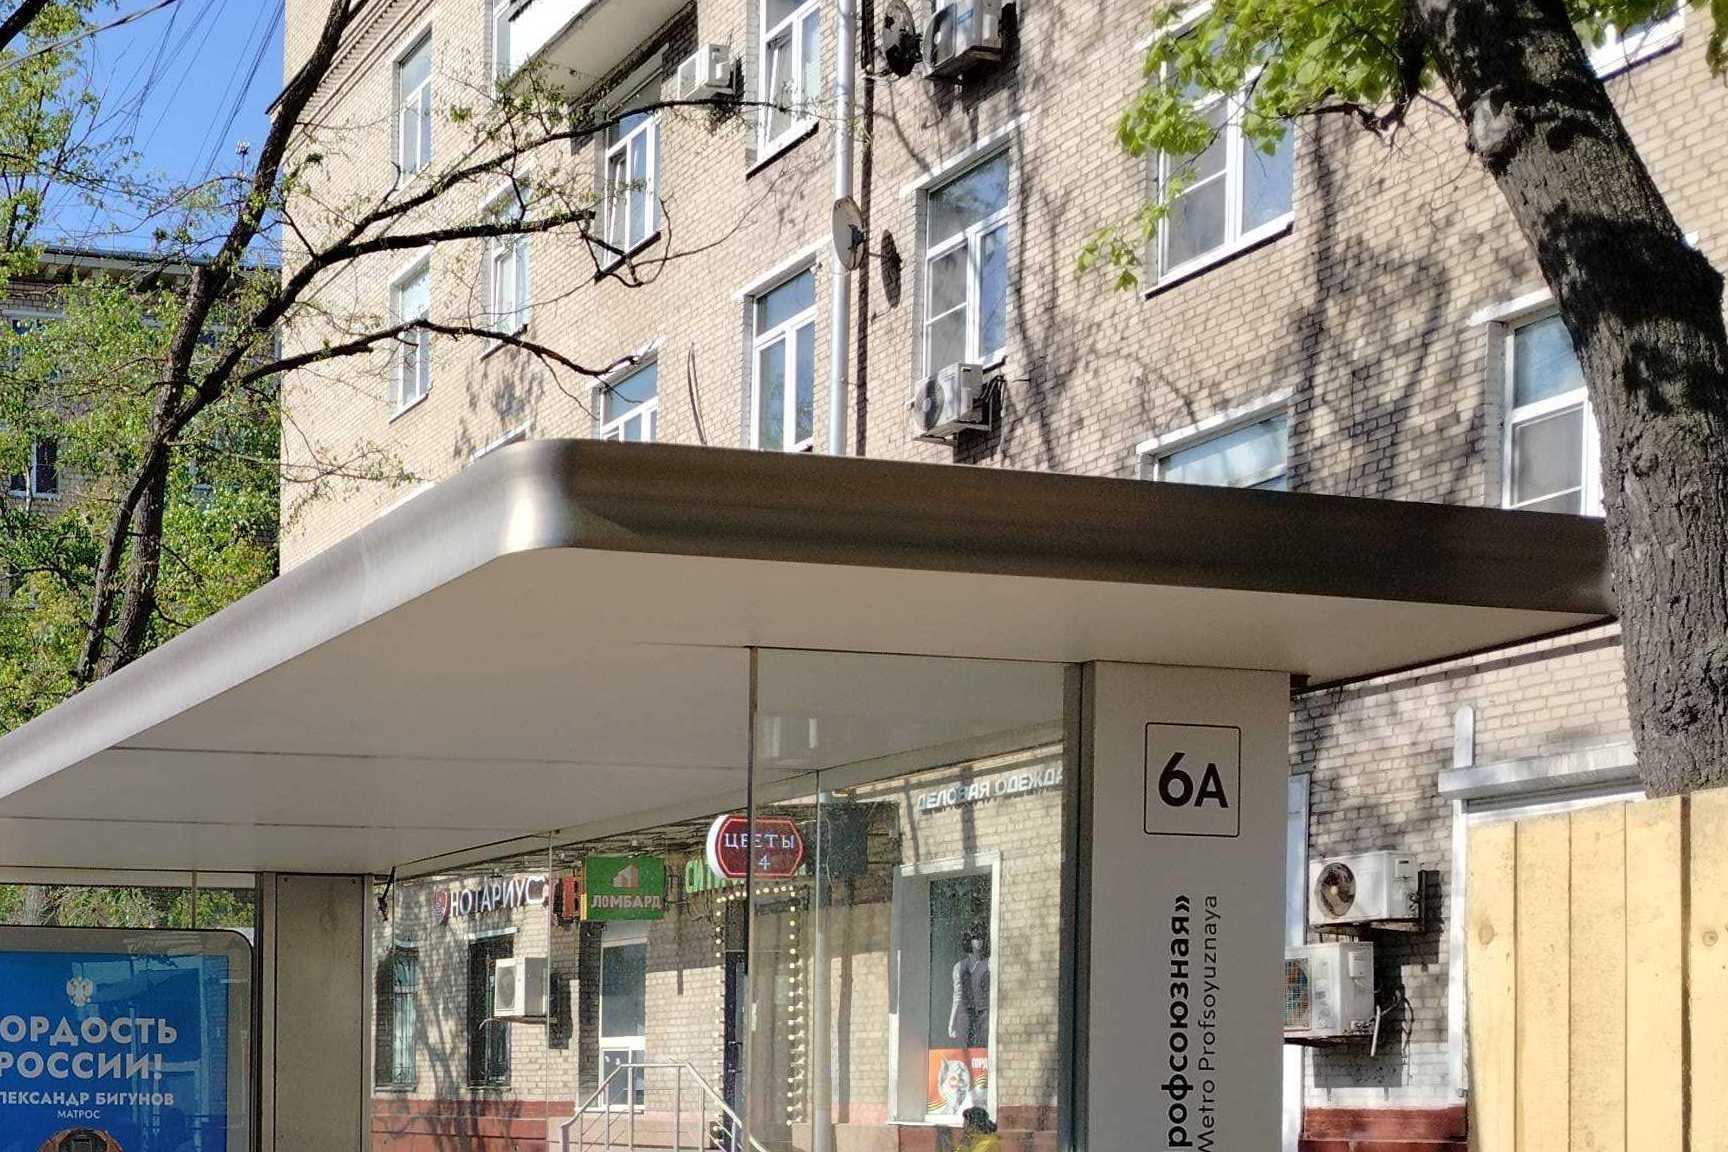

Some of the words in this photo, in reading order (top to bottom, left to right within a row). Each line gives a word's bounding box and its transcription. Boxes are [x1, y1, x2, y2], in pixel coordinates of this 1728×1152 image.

[917, 780, 991, 811] ДЕЛОВАЯ
[724, 833, 795, 849] ЦВЕТЫ
[450, 875, 547, 917] НОТАРИУС
[590, 894, 663, 909] ЛОМБАРД
[1198, 894, 1221, 1071] Profsoyuznaya
[95, 1092, 174, 1105] БИГУНОВ
[56, 1109, 101, 1119] МАТРОС
